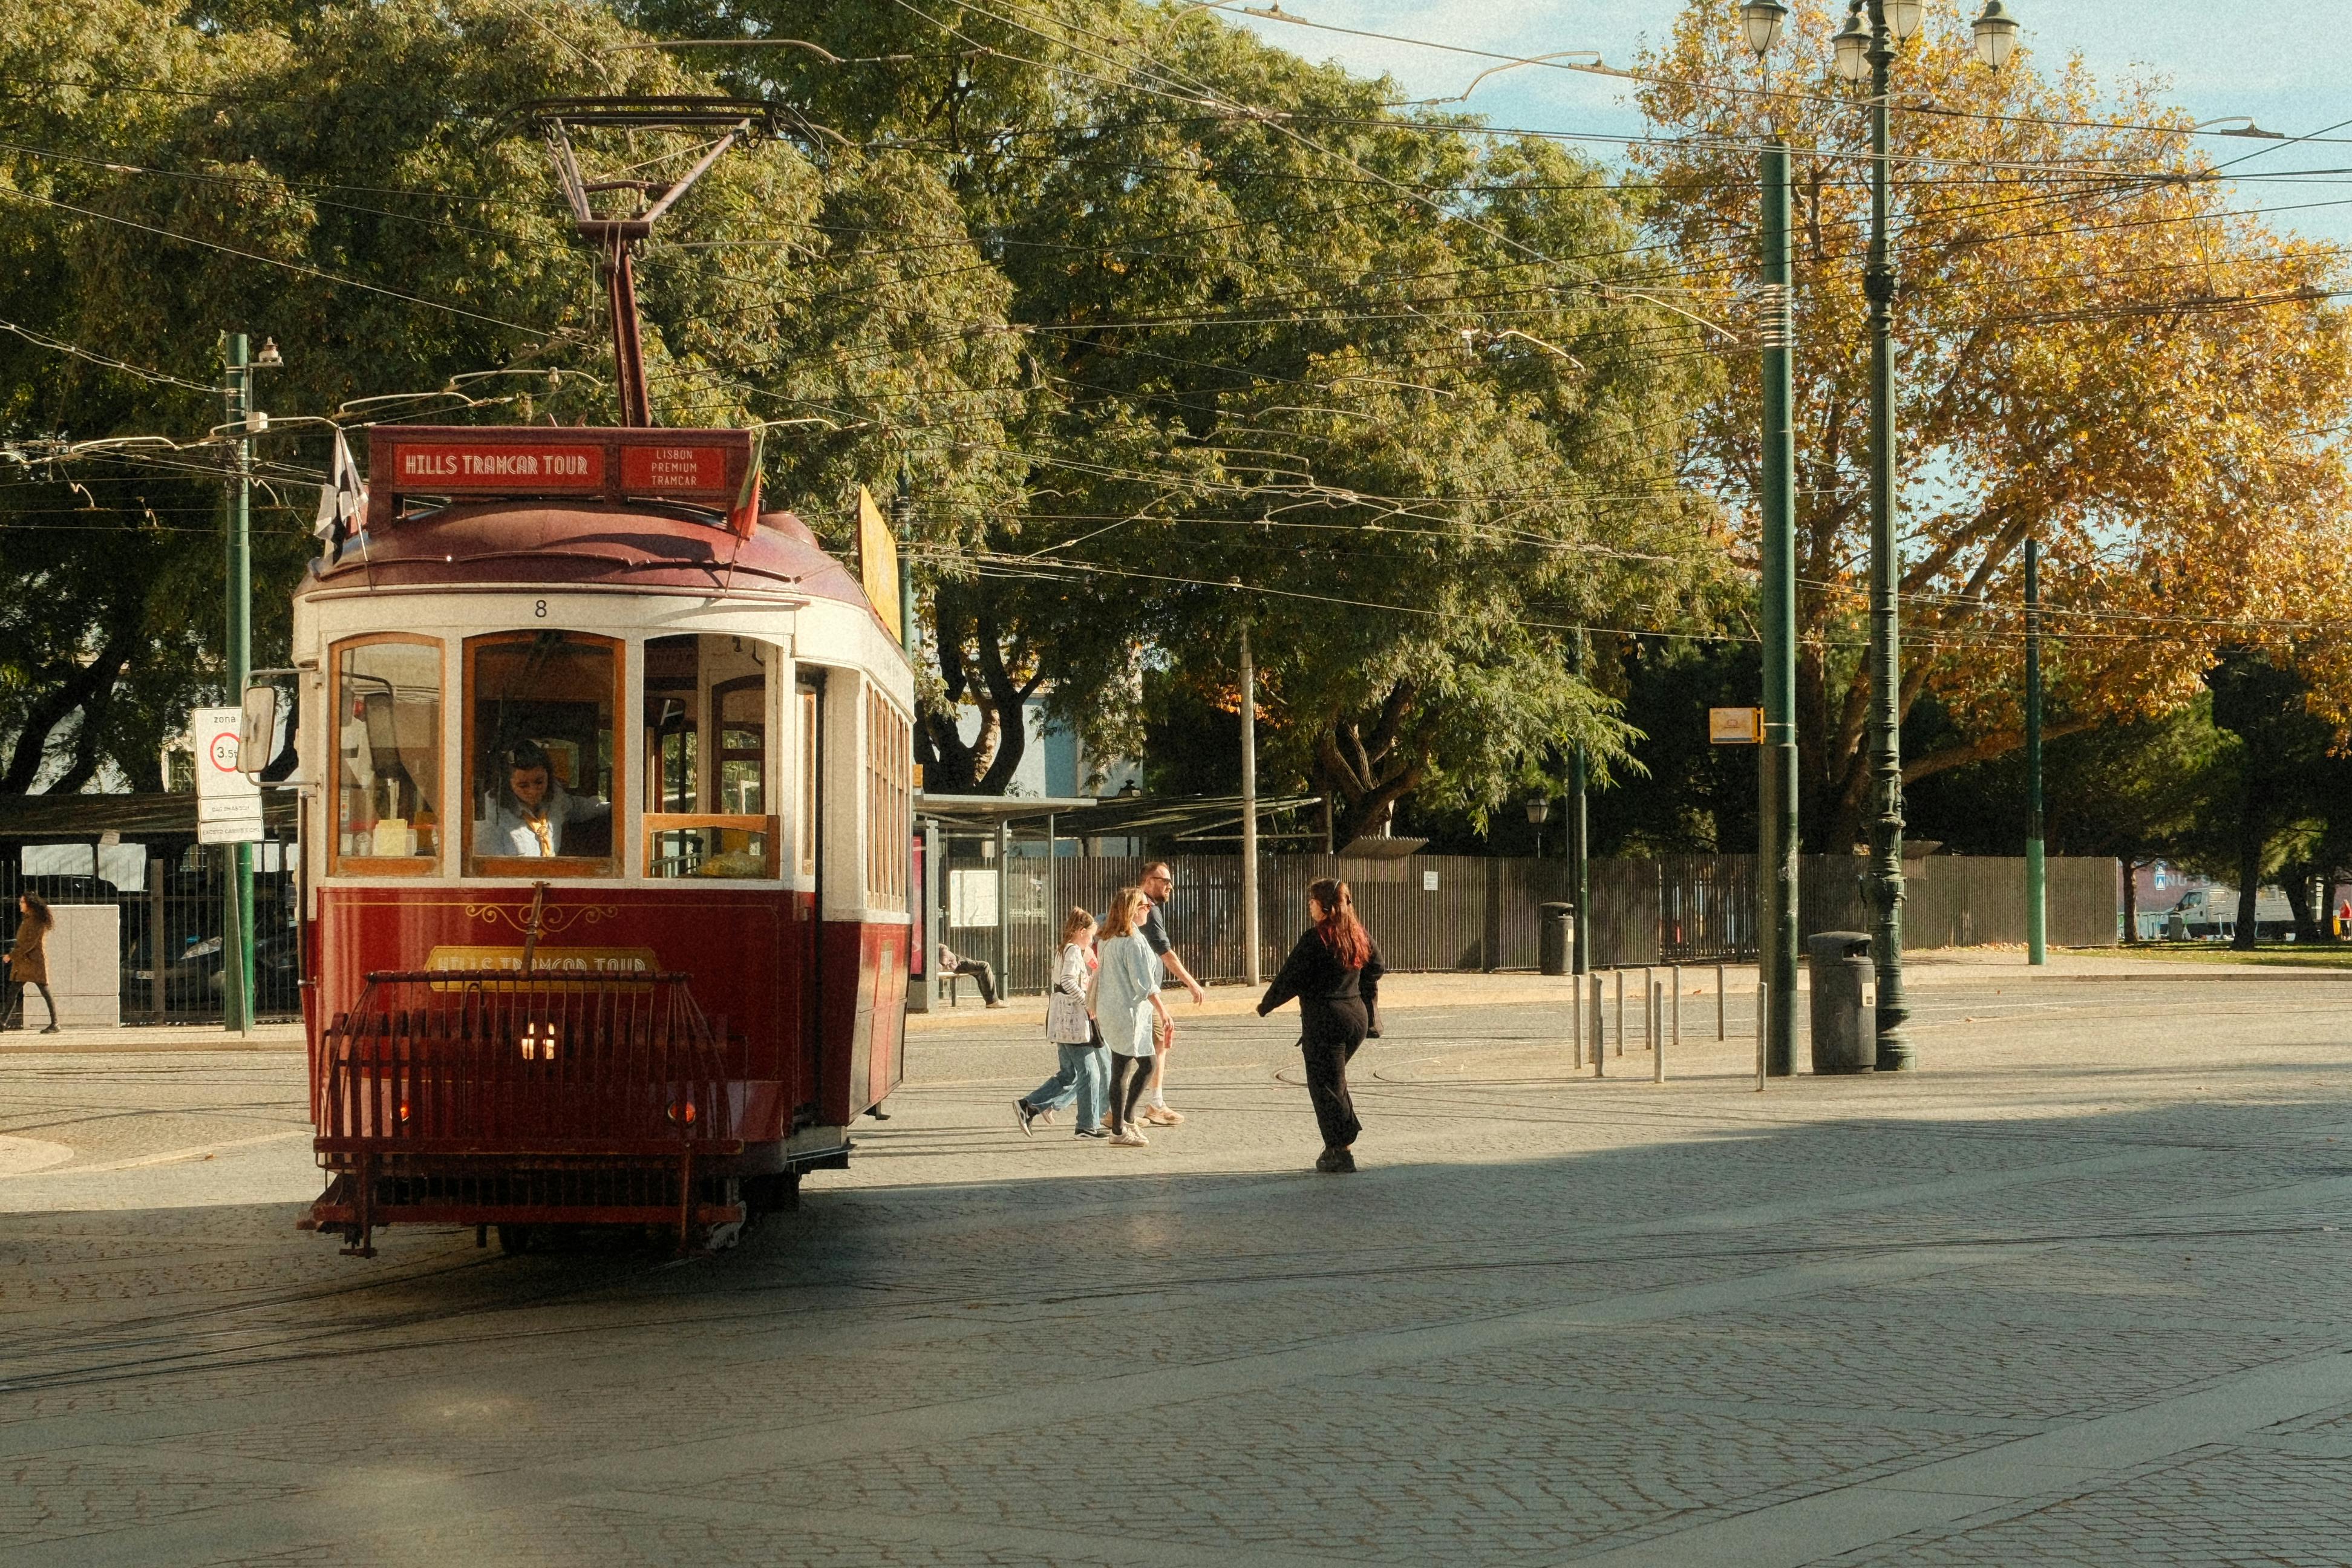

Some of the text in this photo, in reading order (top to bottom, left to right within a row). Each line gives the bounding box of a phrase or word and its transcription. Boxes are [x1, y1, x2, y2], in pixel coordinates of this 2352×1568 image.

[656, 449, 693, 460] LISBON
[406, 455, 588, 475] HILLS TRAMCAR TOUR
[652, 462, 697, 472] PREMIUM
[652, 475, 697, 486] TRAMCAR
[535, 599, 547, 618] 8
[500, 957, 587, 971] TRMCAR
